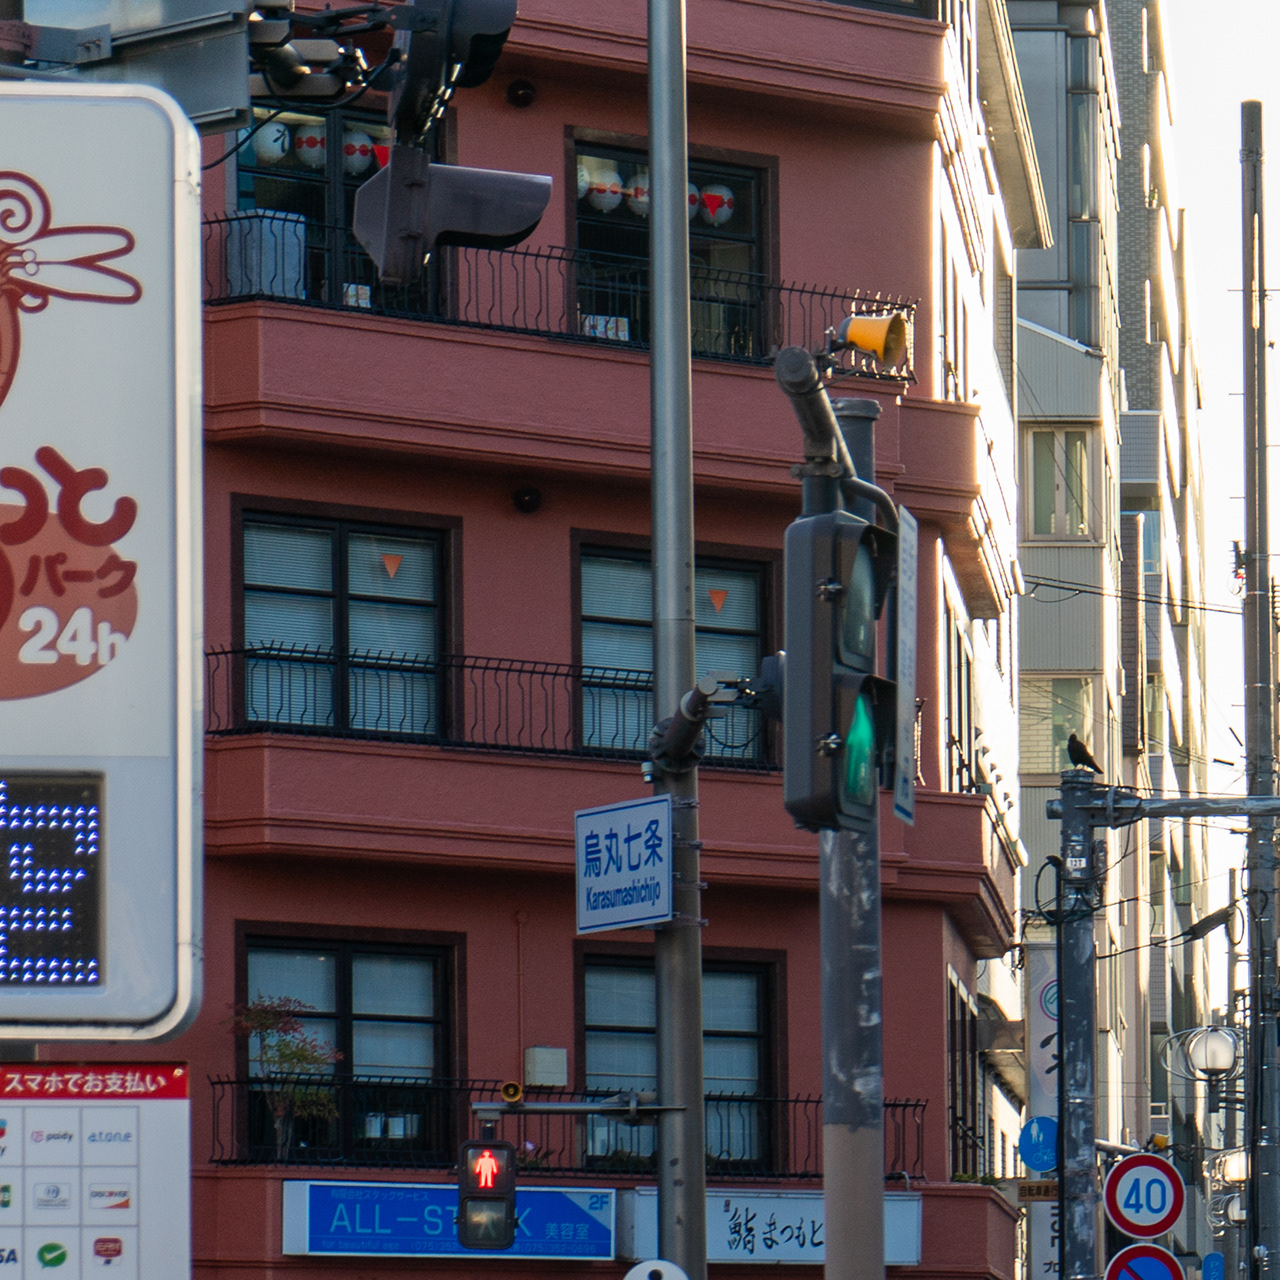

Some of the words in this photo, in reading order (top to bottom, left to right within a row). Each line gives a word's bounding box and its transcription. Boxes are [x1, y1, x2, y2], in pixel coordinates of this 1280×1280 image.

[19, 552, 138, 598] パーク
[584, 819, 663, 877] 烏丸七条
[586, 876, 661, 912] Karasumashichijo
[4, 1072, 167, 1093] スマホでお支払い
[588, 1194, 609, 1211] 2F
[1123, 1178, 1167, 1214] 40
[545, 1222, 589, 1240] 美容室
